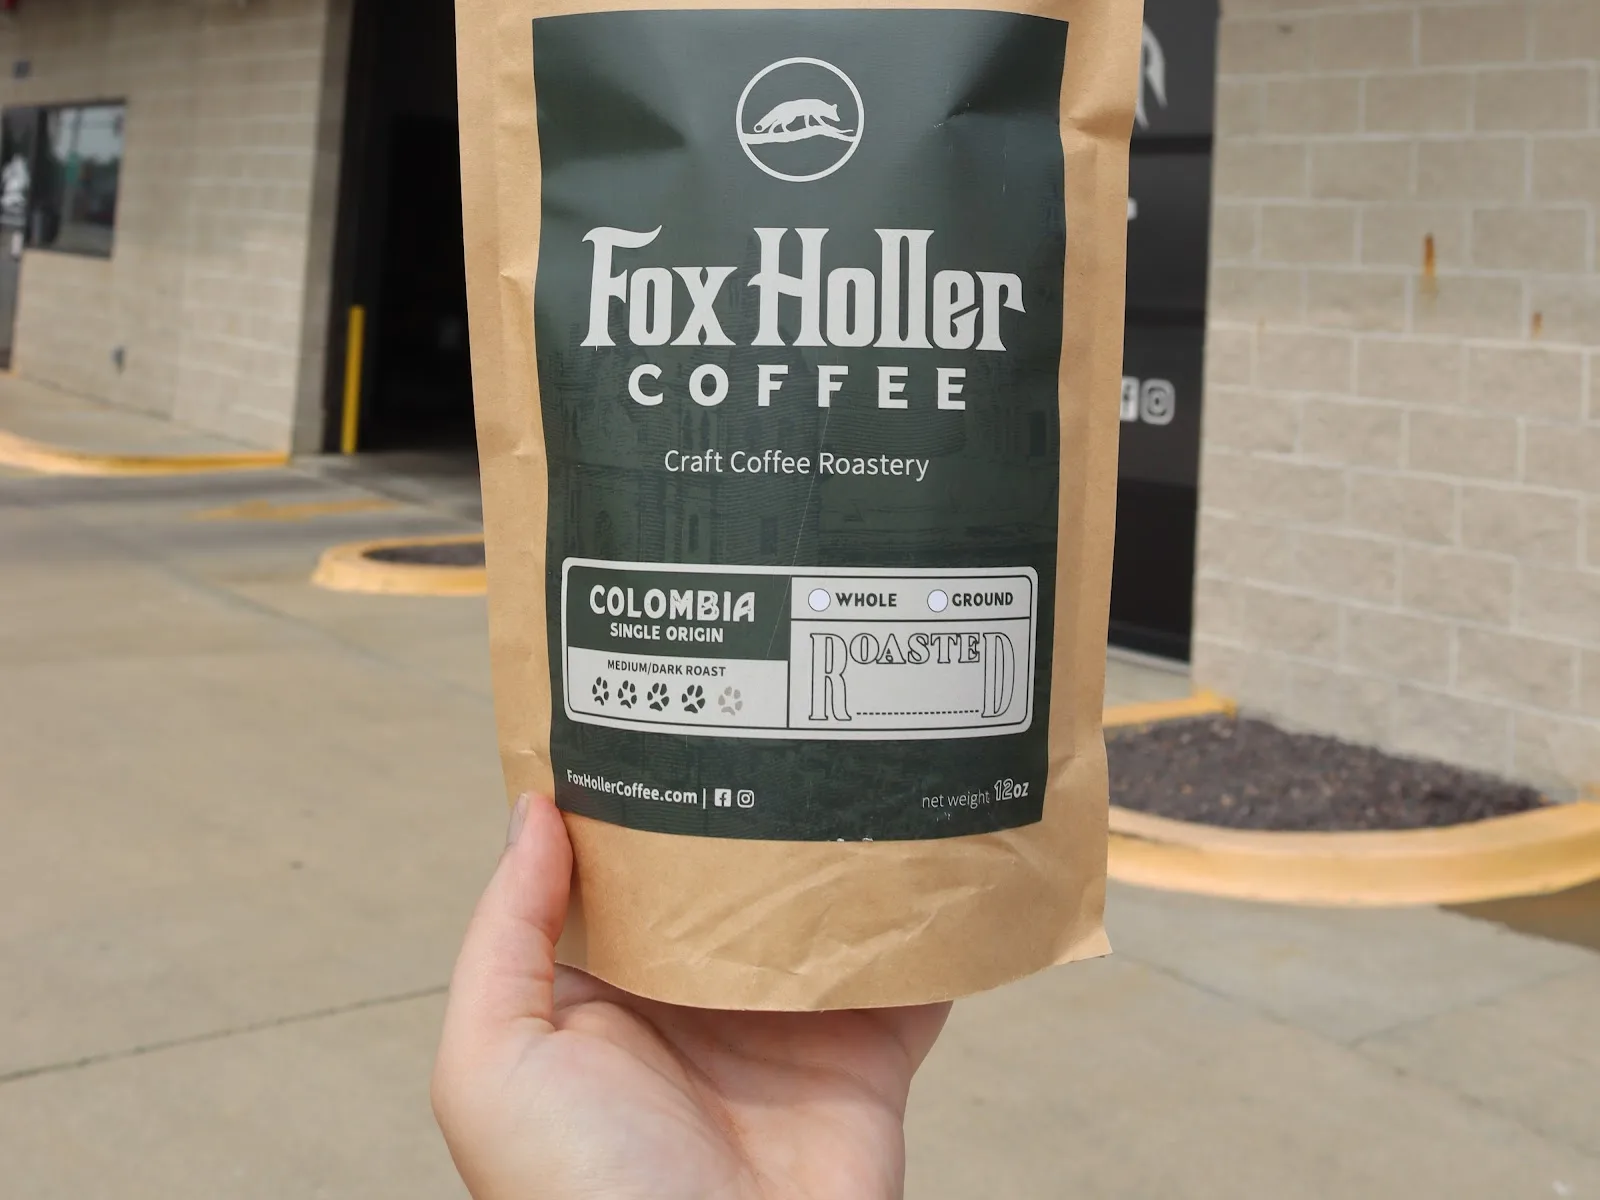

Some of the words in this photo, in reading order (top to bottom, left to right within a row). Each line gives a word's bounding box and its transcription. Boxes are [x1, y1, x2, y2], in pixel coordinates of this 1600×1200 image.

[580, 224, 738, 351] Fox
[747, 227, 1027, 352] Holler
[627, 363, 967, 411] COFFEE
[663, 449, 723, 474] Craft
[729, 450, 811, 475] Coffee
[818, 453, 930, 482] Roastery
[590, 584, 755, 622] COLOMBIA
[835, 592, 898, 608] WHOLE
[951, 591, 1014, 608] GROUND
[609, 622, 661, 641] SINGLE
[665, 624, 724, 643] ORIGIN
[607, 660, 683, 676] MEDIUM/DARK
[686, 665, 727, 677] ROAST
[809, 632, 1015, 721] ROASTED
[567, 770, 698, 804] FoxHollerCoffee.com
[921, 794, 944, 808] net
[947, 789, 990, 811] weight
[994, 778, 1029, 801] 12oz
